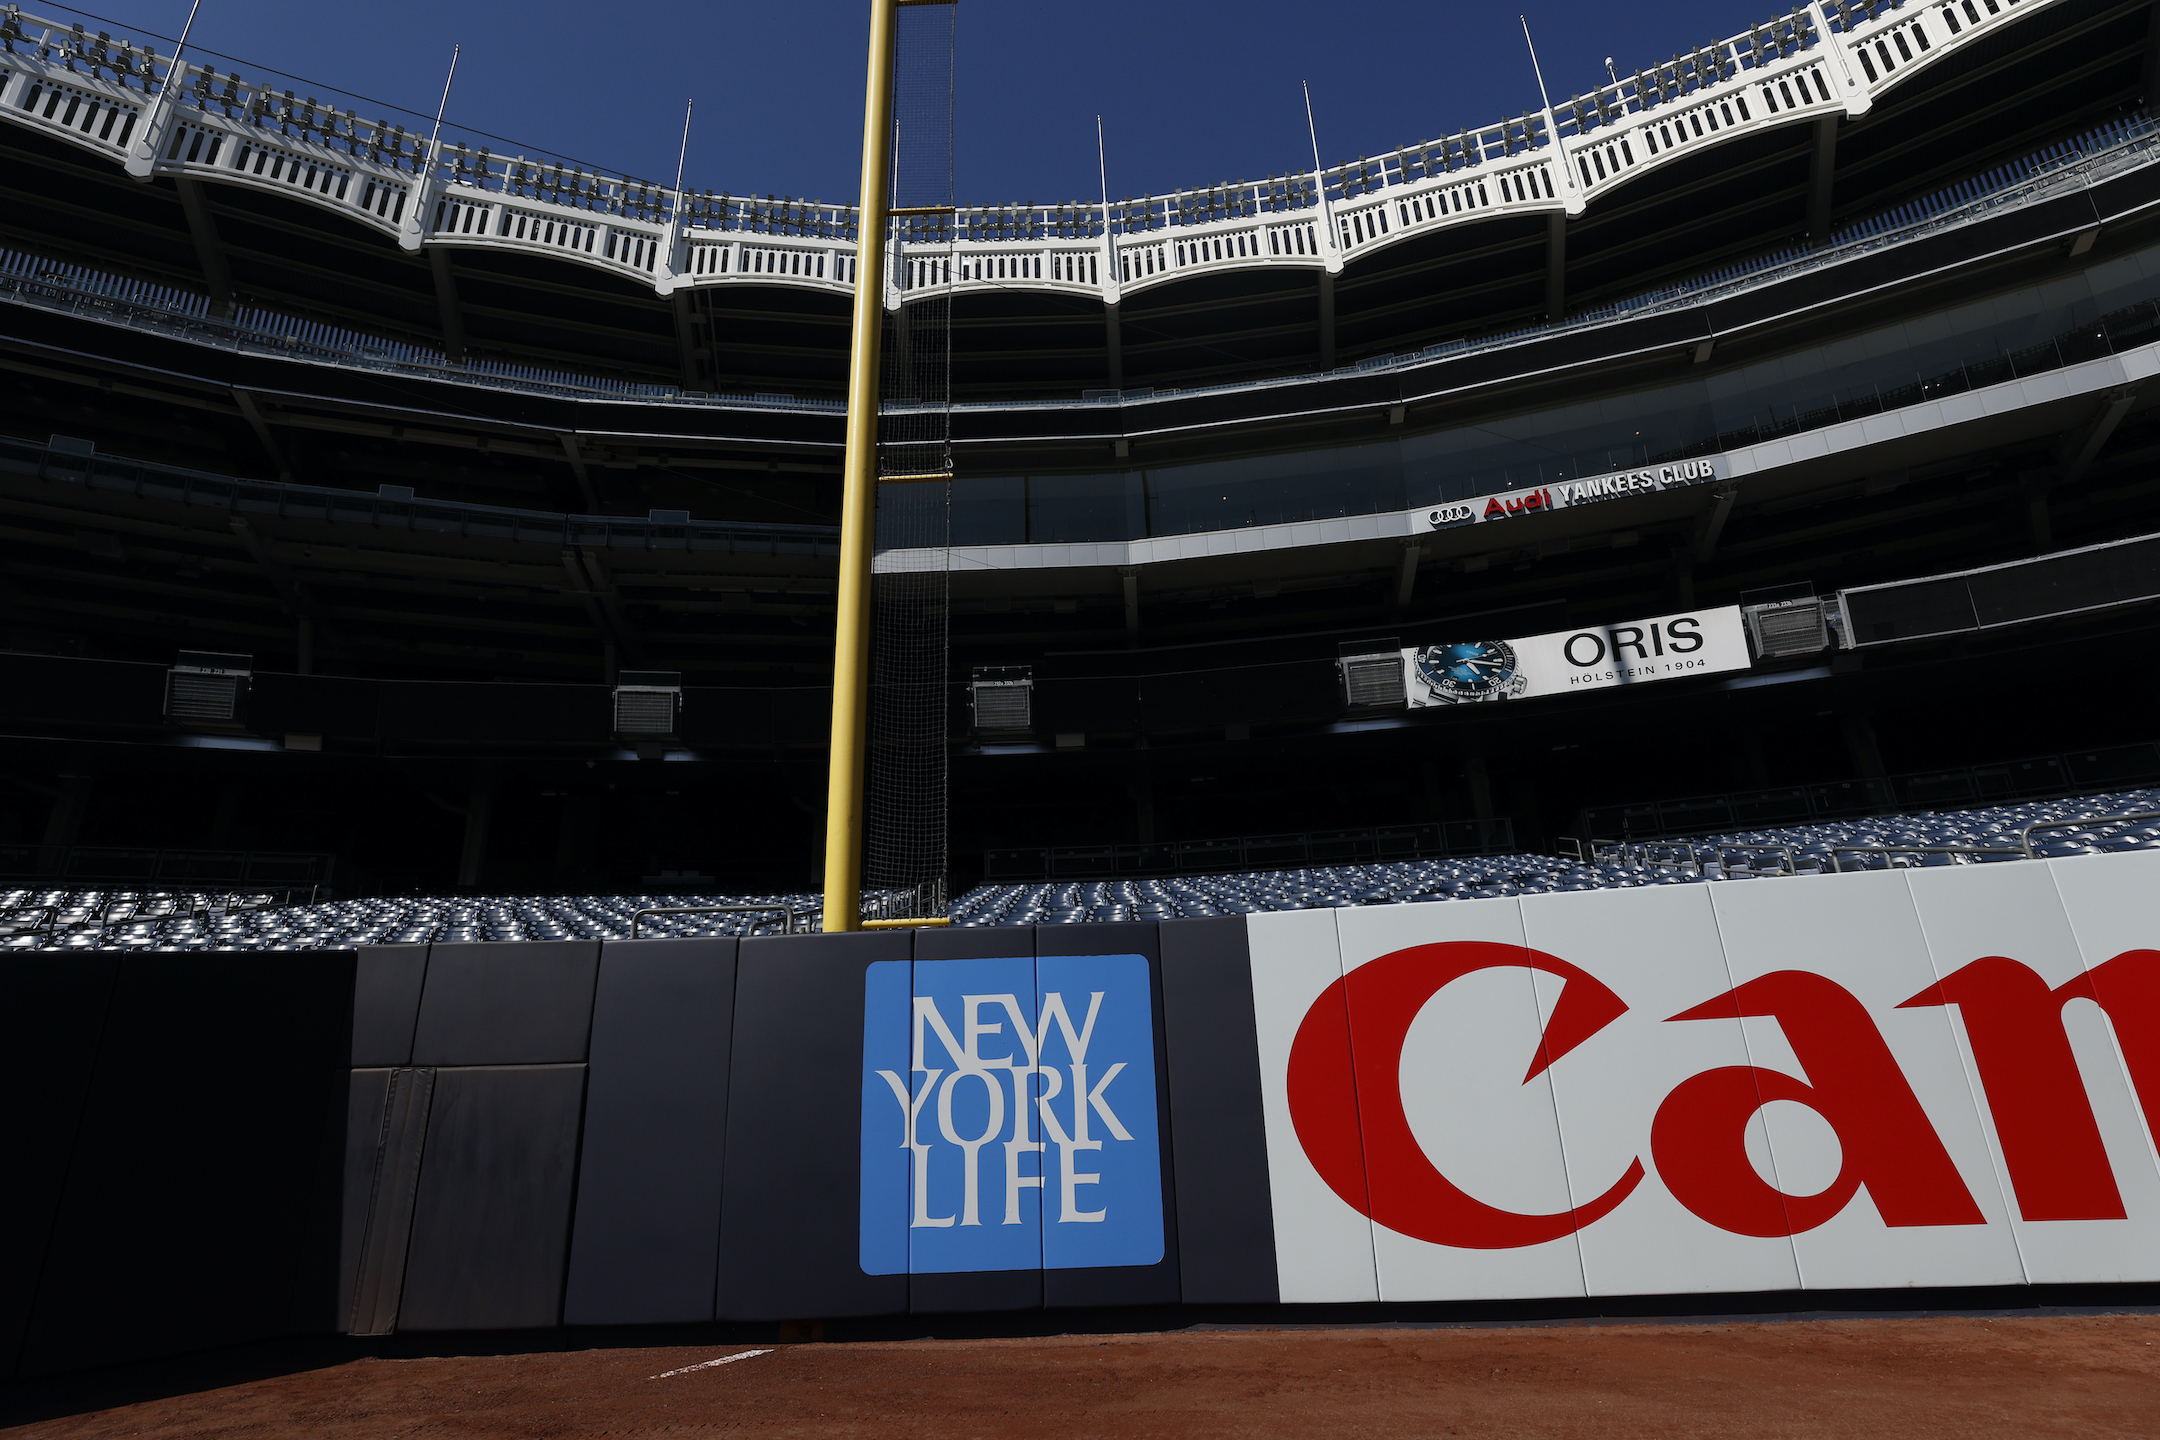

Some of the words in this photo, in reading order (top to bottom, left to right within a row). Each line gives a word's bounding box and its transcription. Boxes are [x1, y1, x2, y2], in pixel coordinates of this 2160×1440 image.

[1485, 488, 1551, 517] Audi
[1558, 469, 1654, 502] YANKEES
[1658, 459, 1714, 485] CLUB
[1564, 617, 1704, 668] ORIS
[1570, 665, 1655, 685] HÖLSTEIN
[1665, 659, 1706, 672] 1904
[910, 991, 1105, 1071] NEW
[874, 1062, 1135, 1148] YORK
[910, 1142, 1107, 1228] LIFE
